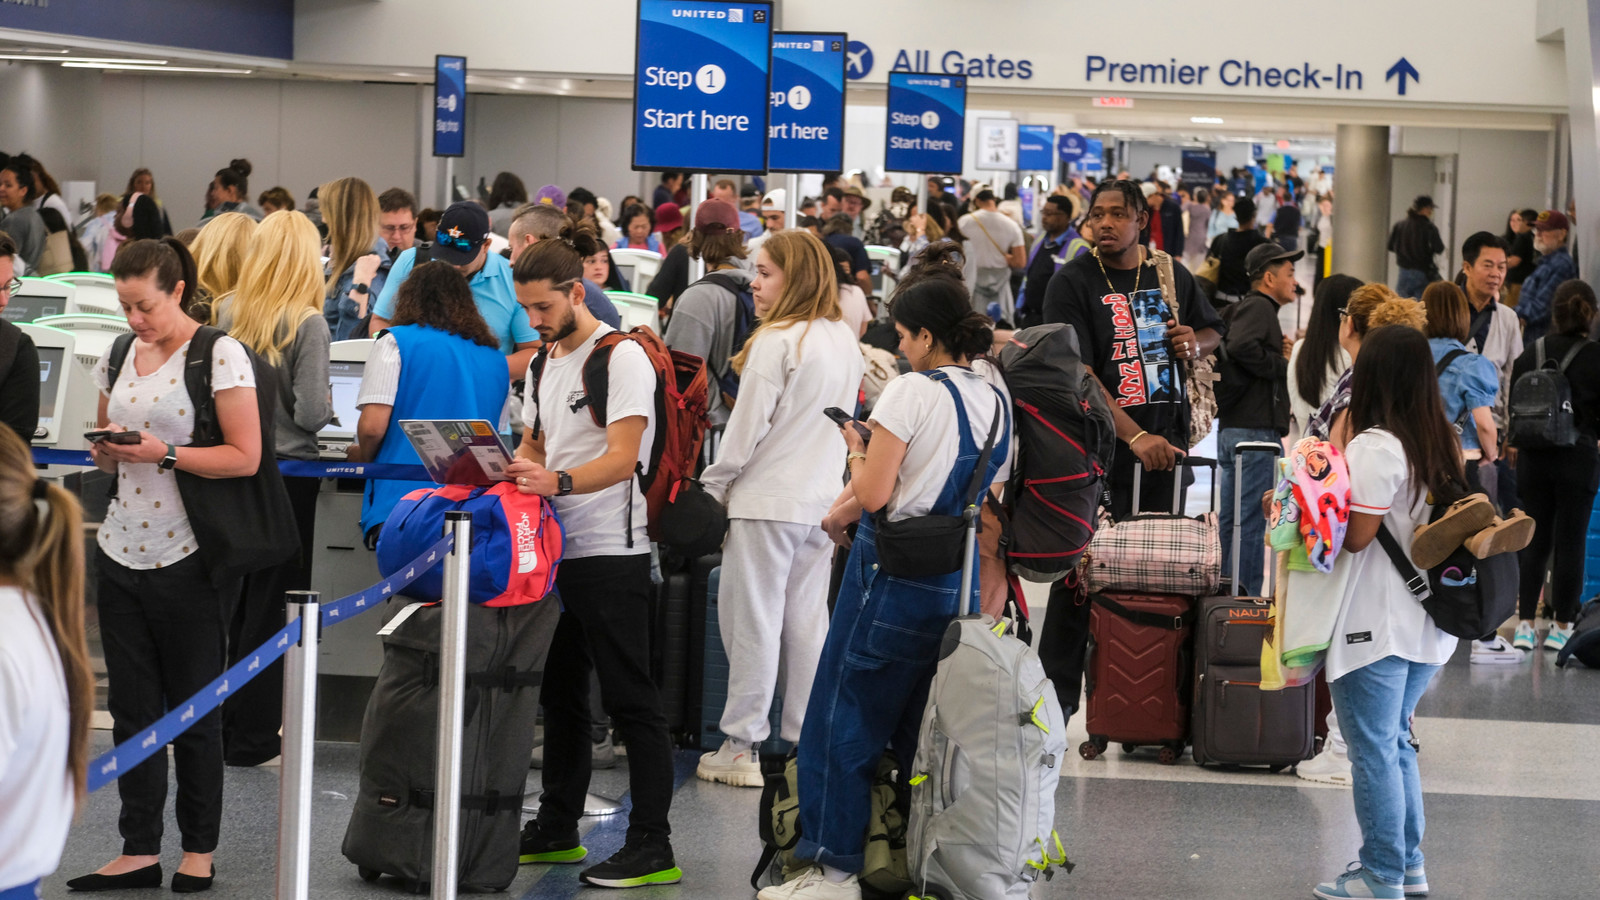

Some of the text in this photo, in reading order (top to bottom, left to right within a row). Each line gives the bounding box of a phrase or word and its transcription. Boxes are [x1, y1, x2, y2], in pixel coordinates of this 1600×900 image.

[672, 9, 727, 19] UNITED
[892, 49, 1033, 80] All Gates
[1085, 55, 1363, 90] Premier Check-In
[645, 66, 716, 90] Step 1
[769, 91, 786, 107] ep
[643, 108, 749, 131] Start here
[891, 112, 920, 126] Step
[791, 122, 829, 140] here
[890, 136, 953, 151] Start here
[1102, 293, 1136, 339] HOOD
[1125, 338, 1139, 359] THE
[1116, 359, 1146, 407] BOYZ
[515, 522, 525, 552] FACE
[520, 512, 530, 552] NORTH
[529, 527, 537, 551] THE
[1229, 608, 1269, 619] NAUT
